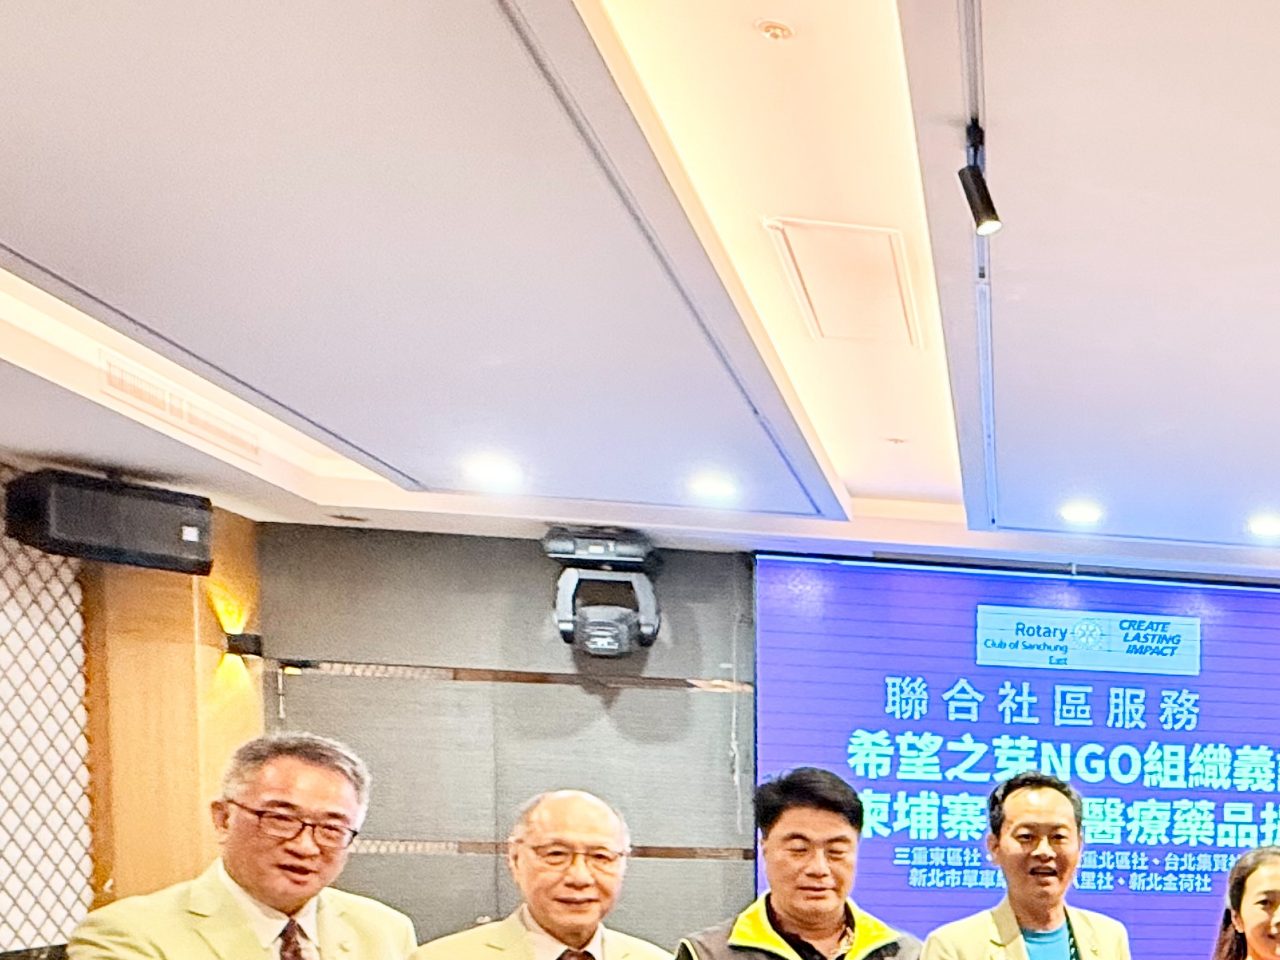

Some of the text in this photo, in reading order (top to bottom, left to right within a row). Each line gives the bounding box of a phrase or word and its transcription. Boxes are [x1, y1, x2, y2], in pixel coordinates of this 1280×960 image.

[1015, 622, 1068, 641] Rotary
[1119, 619, 1171, 632] CREATE
[1009, 640, 1019, 649] of
[1123, 632, 1181, 645] LASTING
[1126, 645, 1178, 657] IMPACT
[884, 676, 1200, 731] 聯合社區服務
